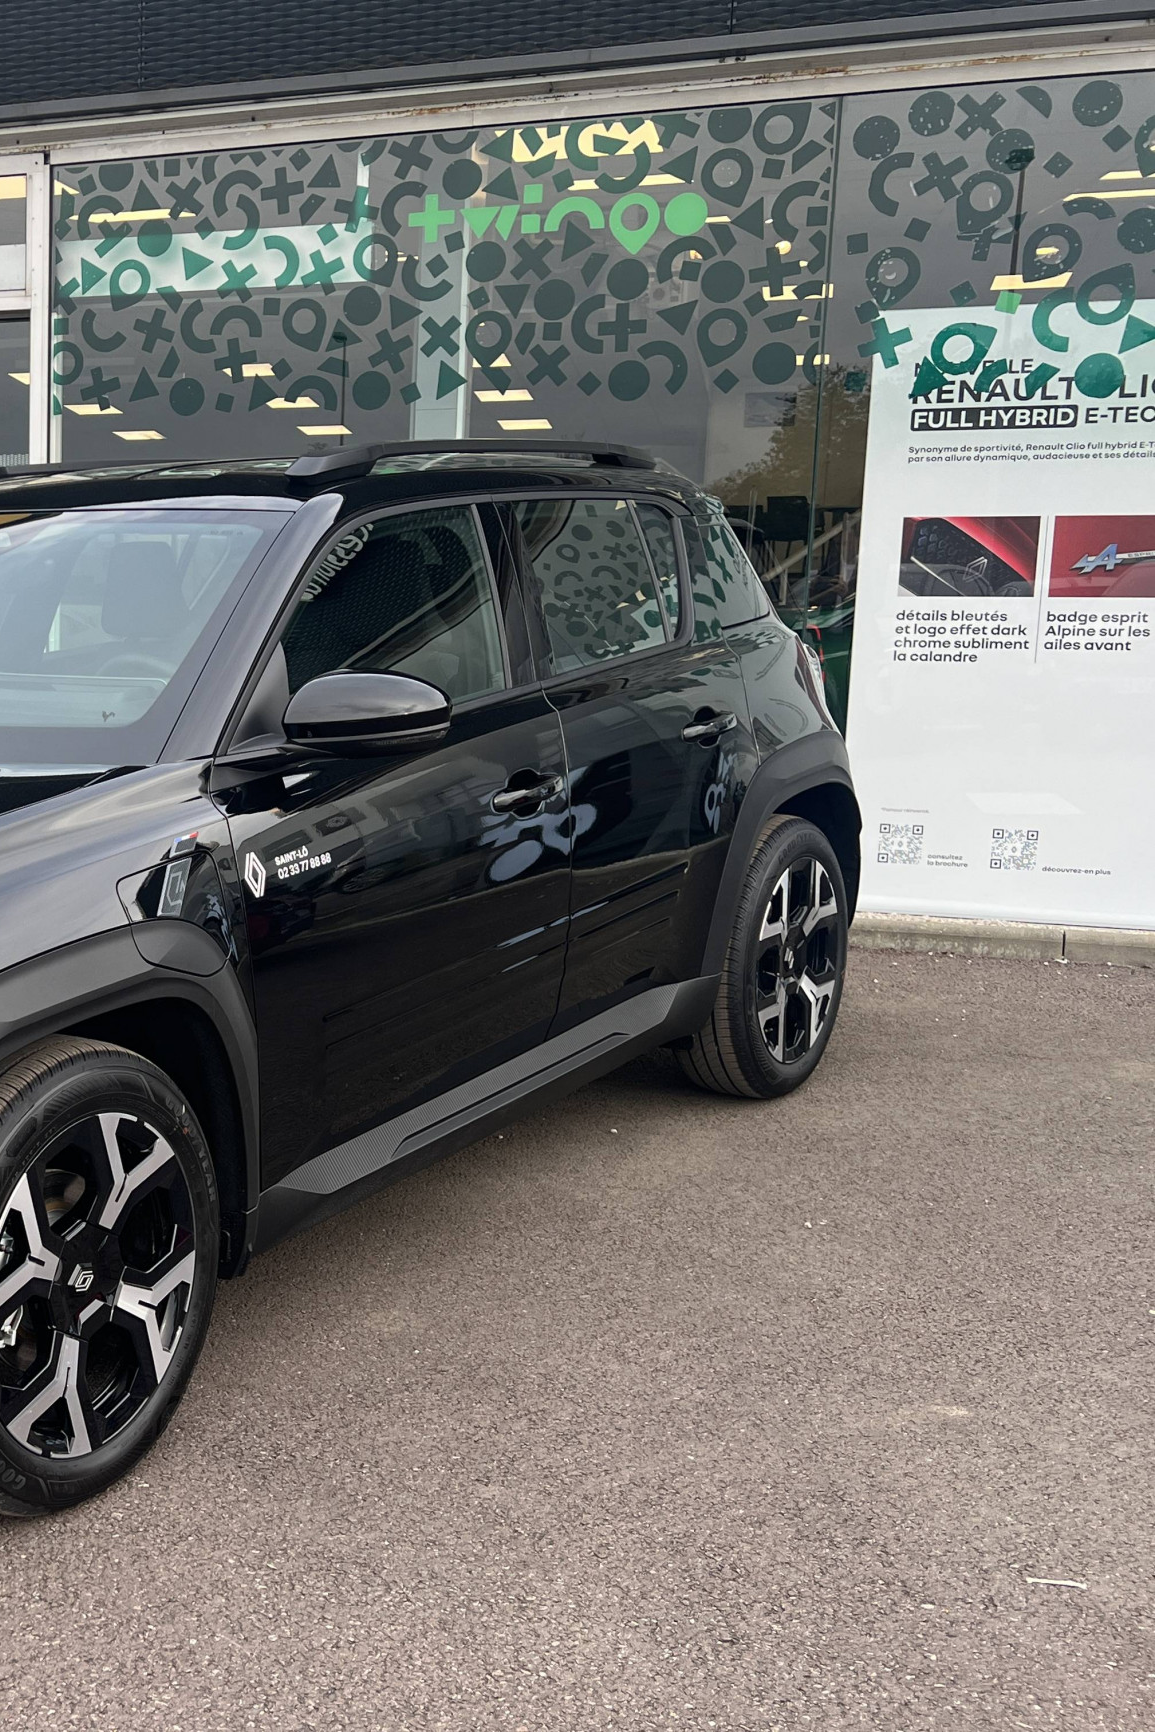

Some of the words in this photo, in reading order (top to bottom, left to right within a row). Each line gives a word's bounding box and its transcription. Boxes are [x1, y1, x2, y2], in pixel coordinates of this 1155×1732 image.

[913, 410, 973, 429] FULL
[979, 408, 1075, 428] HYBRID
[908, 445, 959, 455] Synonyme
[960, 444, 973, 452] de
[973, 442, 1024, 454] sportivité,
[1026, 443, 1064, 451] Renault
[1066, 442, 1085, 450] Clio
[1087, 441, 1104, 450] full
[1104, 441, 1137, 452] hybrid
[1139, 441, 1155, 449] E-T
[908, 455, 924, 464] par
[944, 453, 972, 462] allure
[973, 452, 1031, 464] dynamique,
[1032, 452, 1090, 460] audacieuse
[1092, 451, 1103, 459] et
[896, 610, 947, 622] détails
[950, 610, 1008, 622] bleutés
[1046, 611, 1098, 625] badge
[1101, 611, 1149, 626] esprit
[895, 625, 911, 635] et
[914, 624, 947, 638] logo
[950, 624, 988, 635] effet
[991, 624, 1027, 636] dark
[1044, 625, 1096, 639] Alpine
[1099, 627, 1125, 637] sur
[1128, 626, 1151, 638] les
[894, 637, 951, 649] chrome
[953, 637, 1030, 650] subliment
[1043, 639, 1081, 650] ailes
[1084, 640, 1132, 651] avant
[893, 651, 907, 662] la
[909, 651, 978, 663] calandre
[274, 845, 309, 866] SAINT-LÔ
[277, 868, 290, 880] 02
[289, 863, 300, 876] 33
[299, 859, 309, 872] 77
